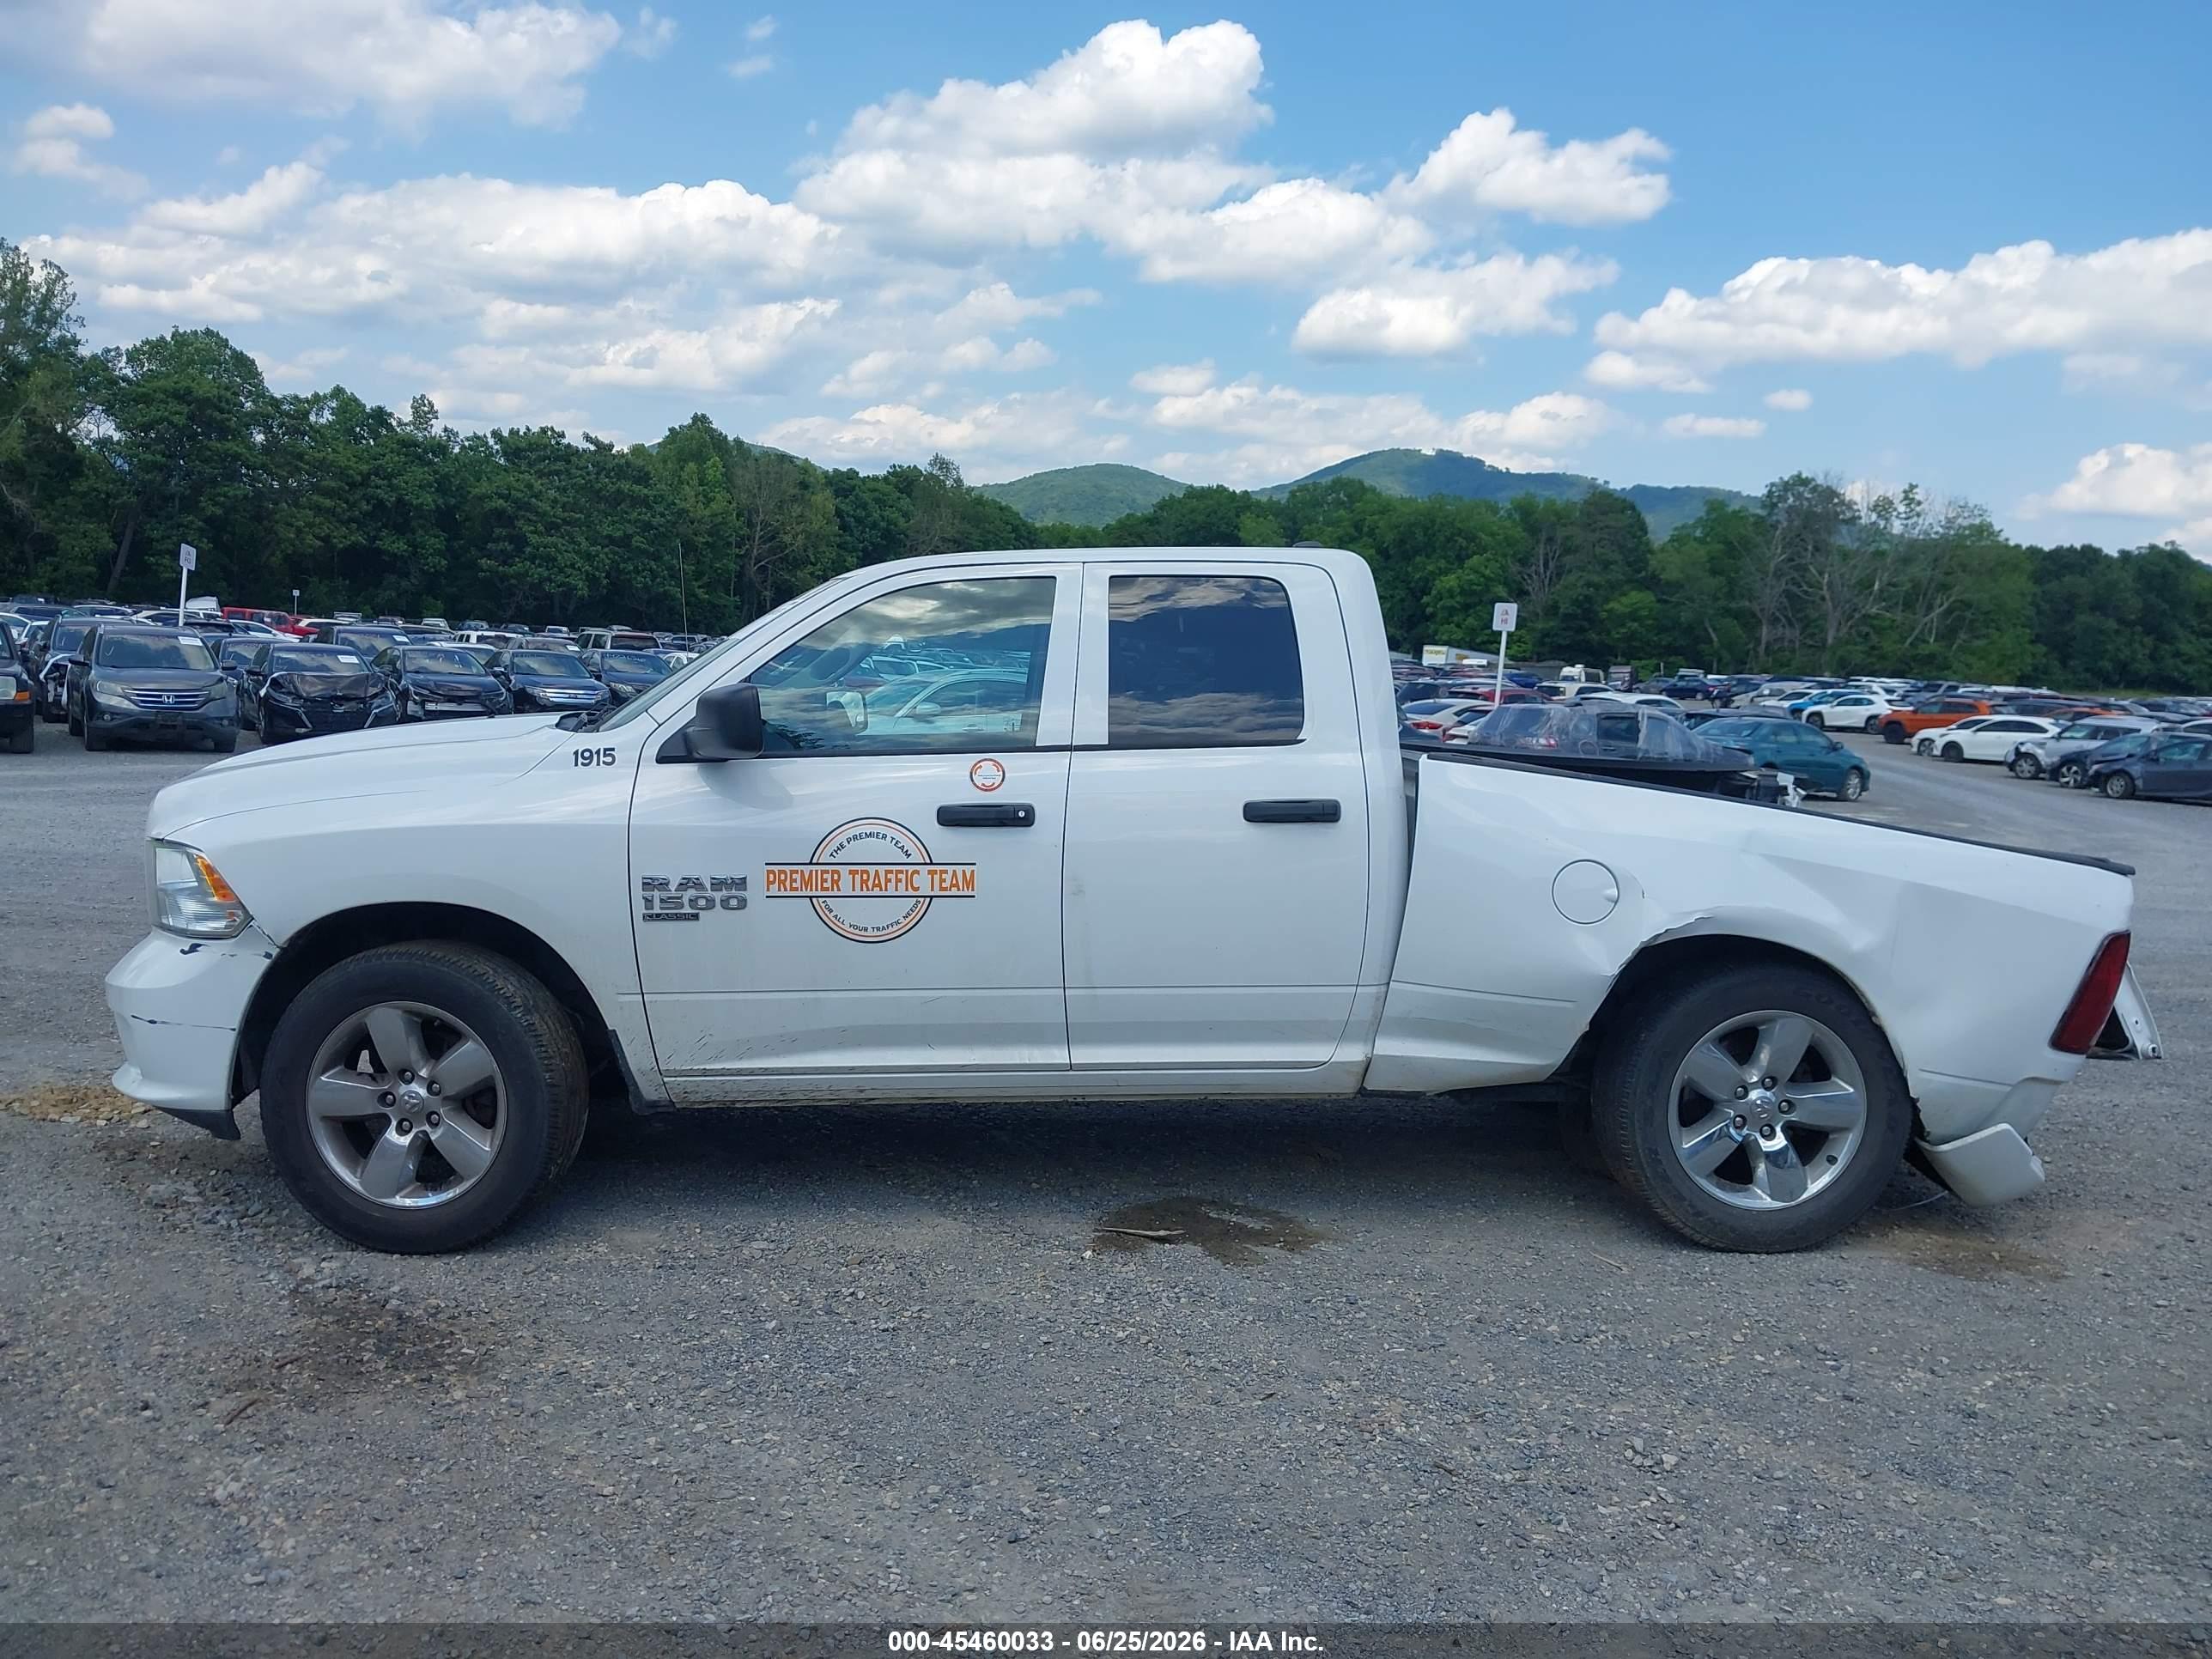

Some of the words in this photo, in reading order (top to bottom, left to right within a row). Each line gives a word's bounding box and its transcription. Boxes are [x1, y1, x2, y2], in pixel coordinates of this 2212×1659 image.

[573, 747, 617, 767] 1915
[829, 841, 847, 860] THE
[847, 830, 888, 845] PREMIER
[890, 836, 912, 860] TEAM
[641, 875, 747, 892] RAM
[765, 868, 842, 892] PREMIER
[848, 868, 921, 892] TRAFFIC
[927, 868, 975, 892] TEAM
[642, 893, 747, 910] 1500
[821, 899, 834, 915] FOR
[832, 913, 846, 926] ALL
[848, 921, 869, 933] YOUR
[870, 918, 902, 933] TRAFFIC
[902, 898, 921, 921] NEEDS
